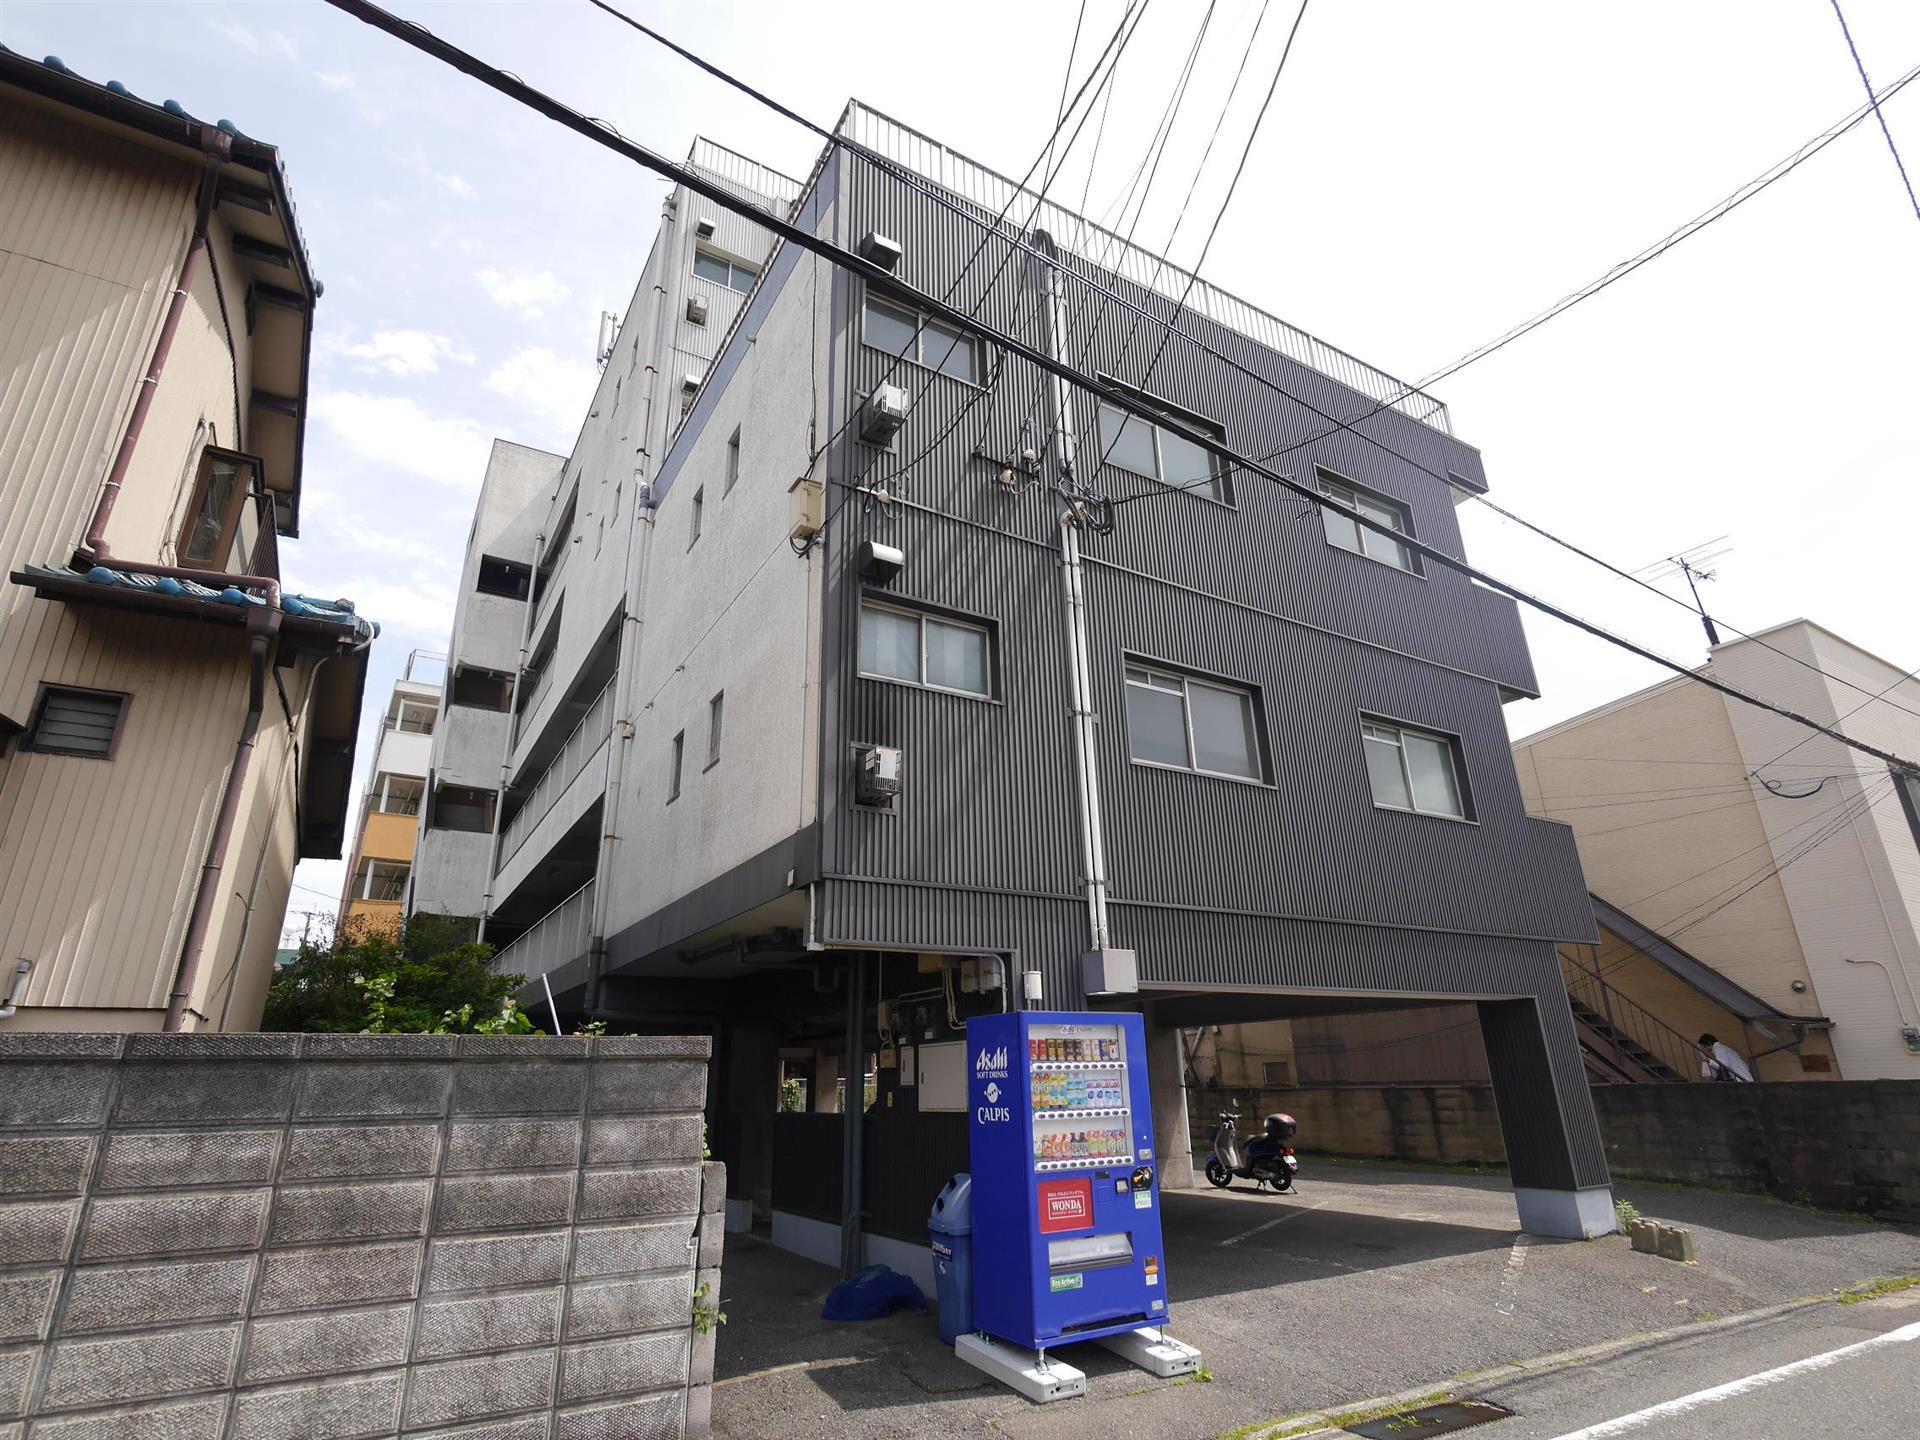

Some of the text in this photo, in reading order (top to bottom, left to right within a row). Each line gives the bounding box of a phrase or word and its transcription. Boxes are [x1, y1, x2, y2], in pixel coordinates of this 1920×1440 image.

[976, 1046, 1008, 1071] Asahi
[976, 1070, 1009, 1079] SOFT DRINKS
[977, 1107, 1010, 1124] CALPIS
[1051, 1199, 1082, 1211] WONDA
